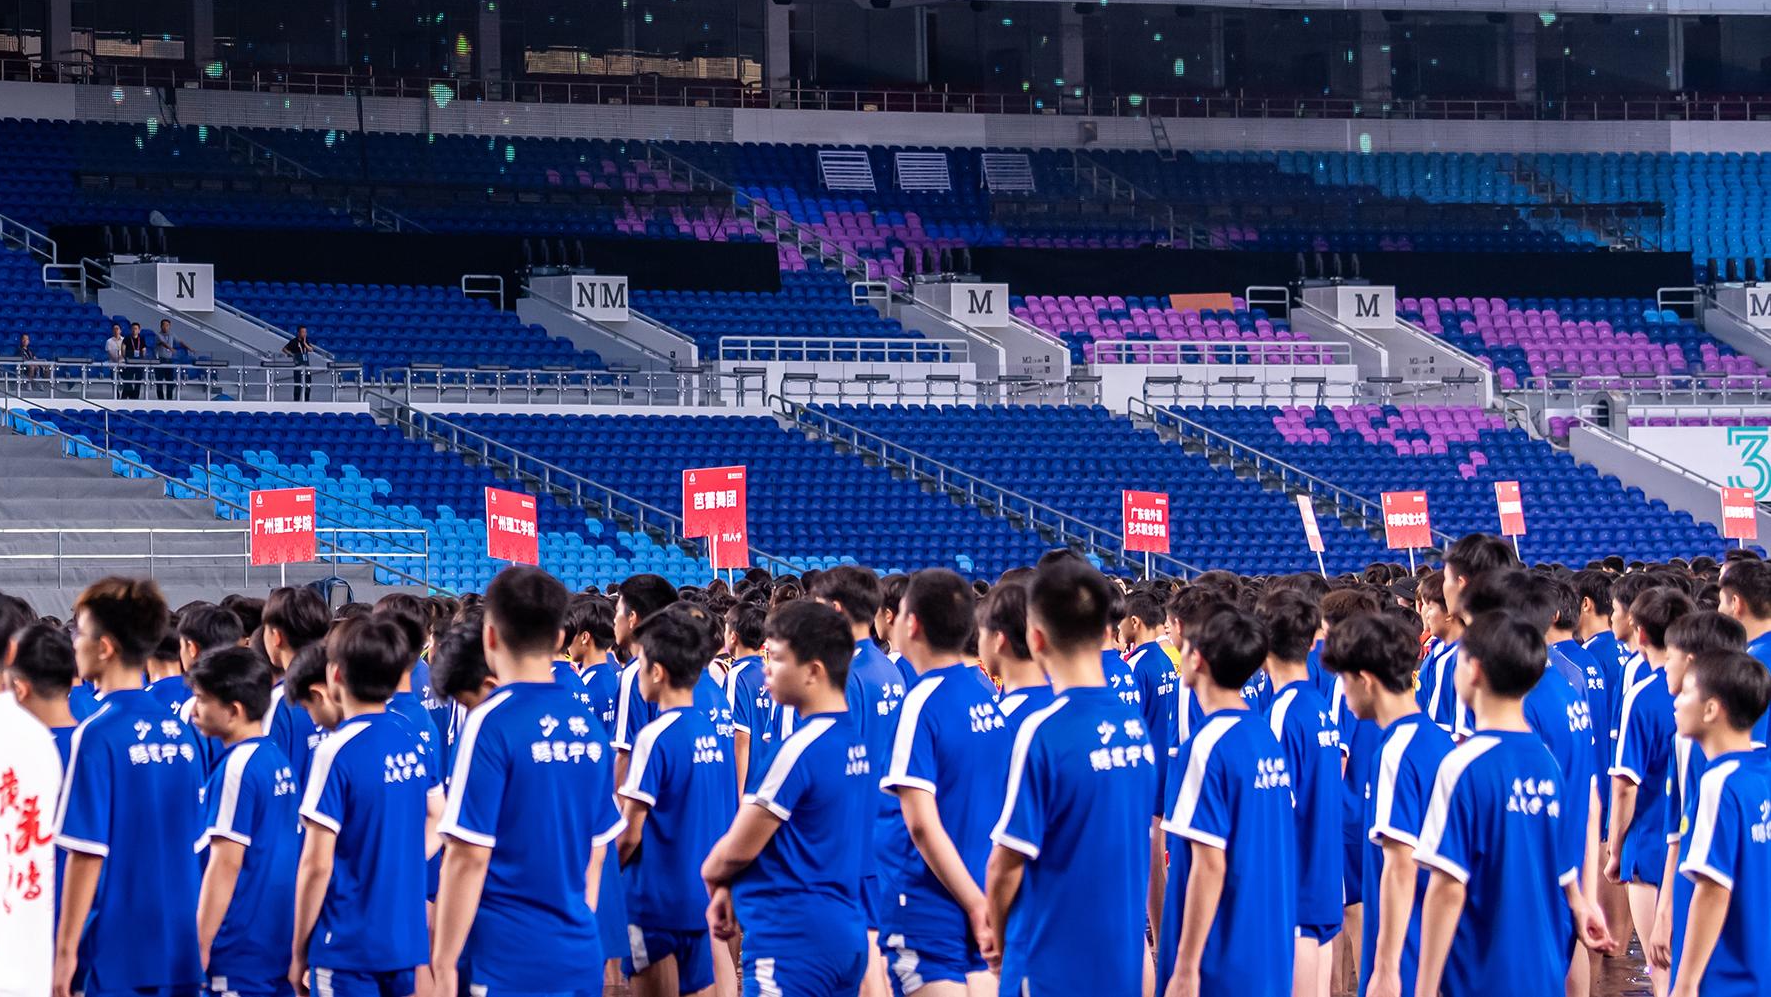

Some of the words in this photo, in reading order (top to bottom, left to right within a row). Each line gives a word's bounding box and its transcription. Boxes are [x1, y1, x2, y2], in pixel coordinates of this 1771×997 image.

[175, 271, 196, 299] N
[968, 289, 994, 315] M
[1355, 294, 1381, 318] M
[1727, 416, 1771, 501] 3
[254, 515, 313, 535] 广州理工学院
[134, 720, 182, 740] 少林
[539, 715, 590, 737] 少林
[1096, 720, 1145, 745] 少林
